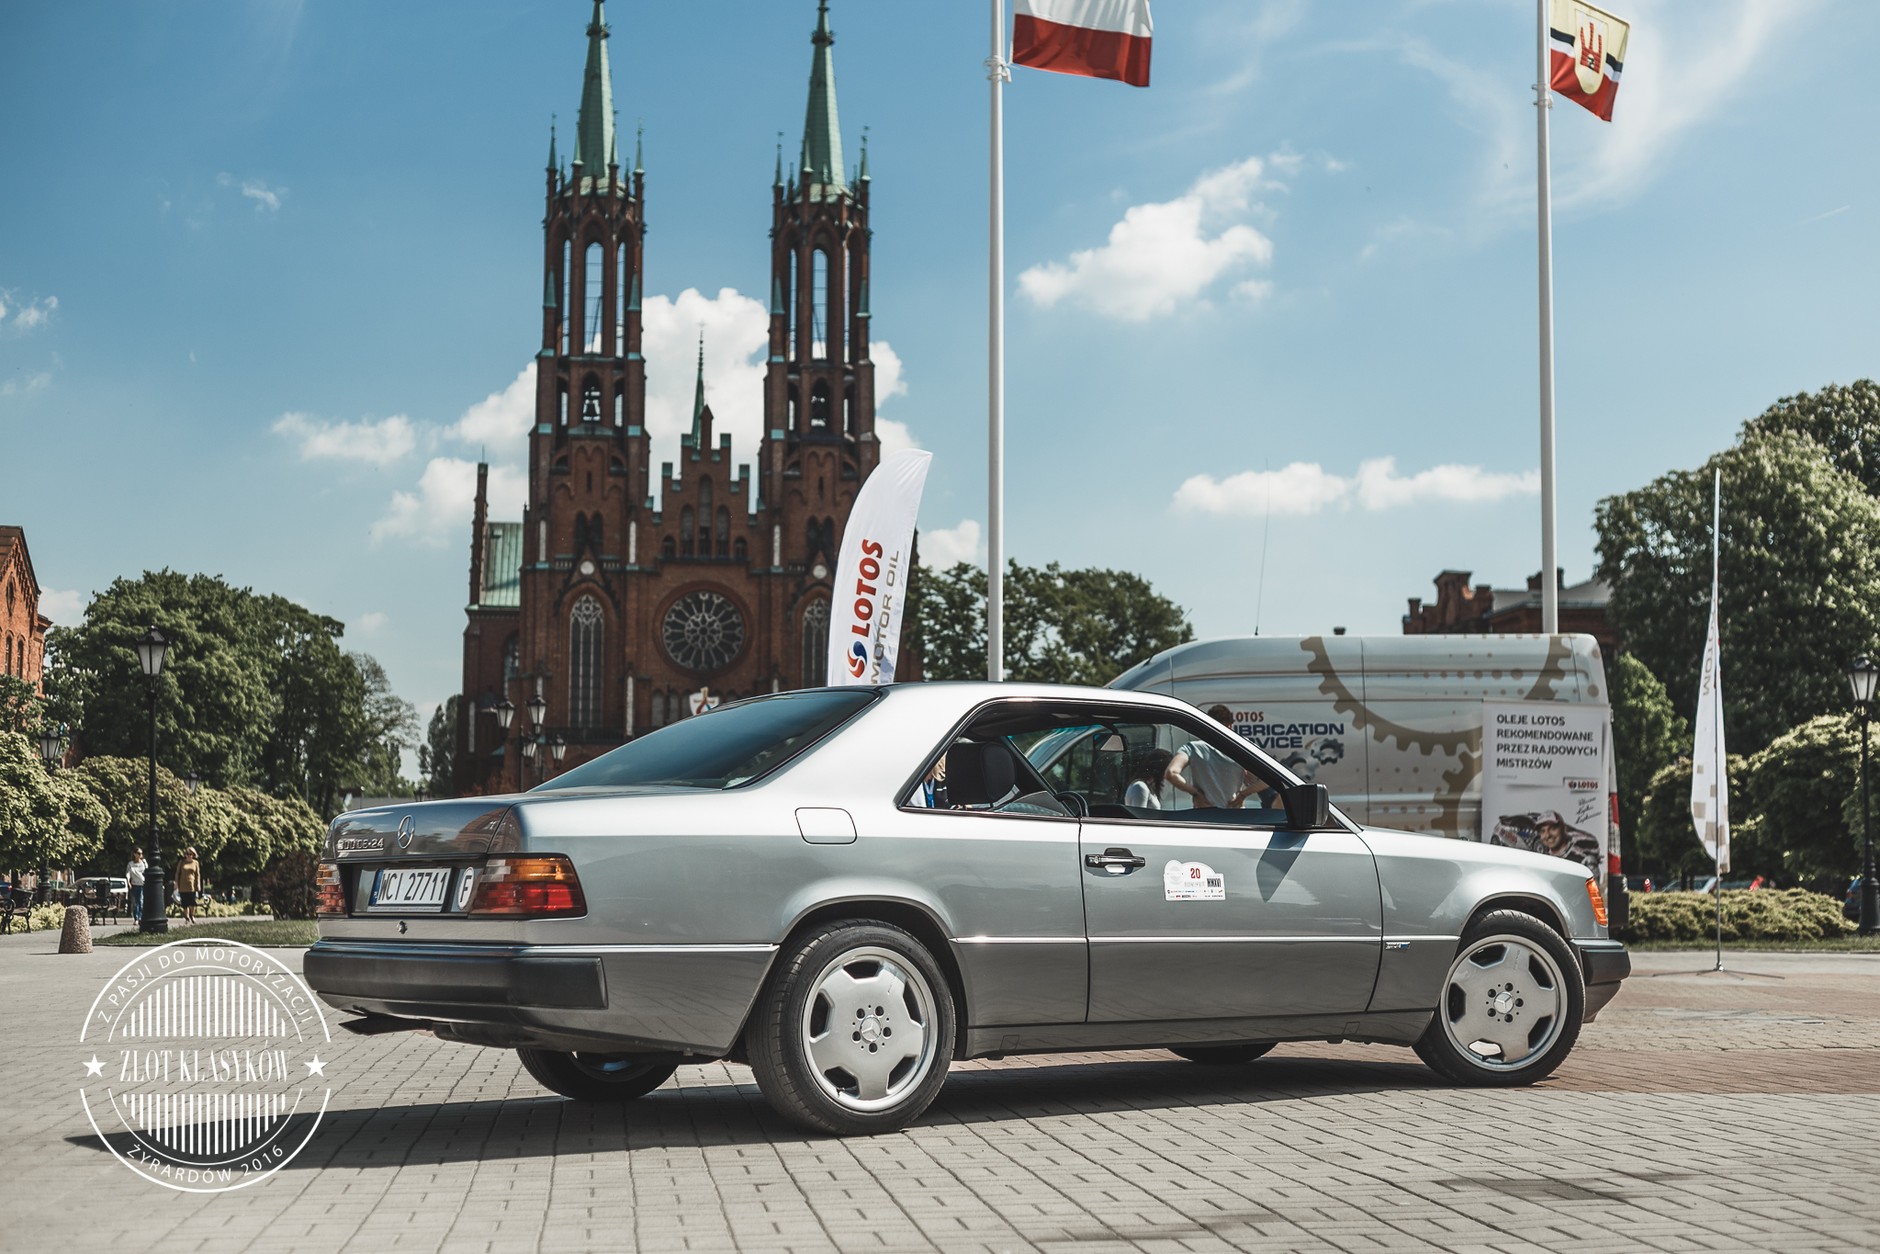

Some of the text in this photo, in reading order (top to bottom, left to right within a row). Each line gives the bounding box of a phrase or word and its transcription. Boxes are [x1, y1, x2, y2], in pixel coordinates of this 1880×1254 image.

[851, 538, 884, 638] LOTOS
[871, 549, 900, 684] MOTOR OIL
[1496, 714, 1565, 726] OLEJE LOTOS
[1496, 729, 1594, 741] REKOMENDOWANE
[1496, 743, 1598, 756] PRZEZ RAJDOWYCH
[1496, 757, 1552, 769] MISTRZÓW
[1577, 780, 1598, 789] LOTOS
[1190, 867, 1201, 879] 20
[377, 871, 448, 901] WCI 27711
[459, 875, 472, 903] F
